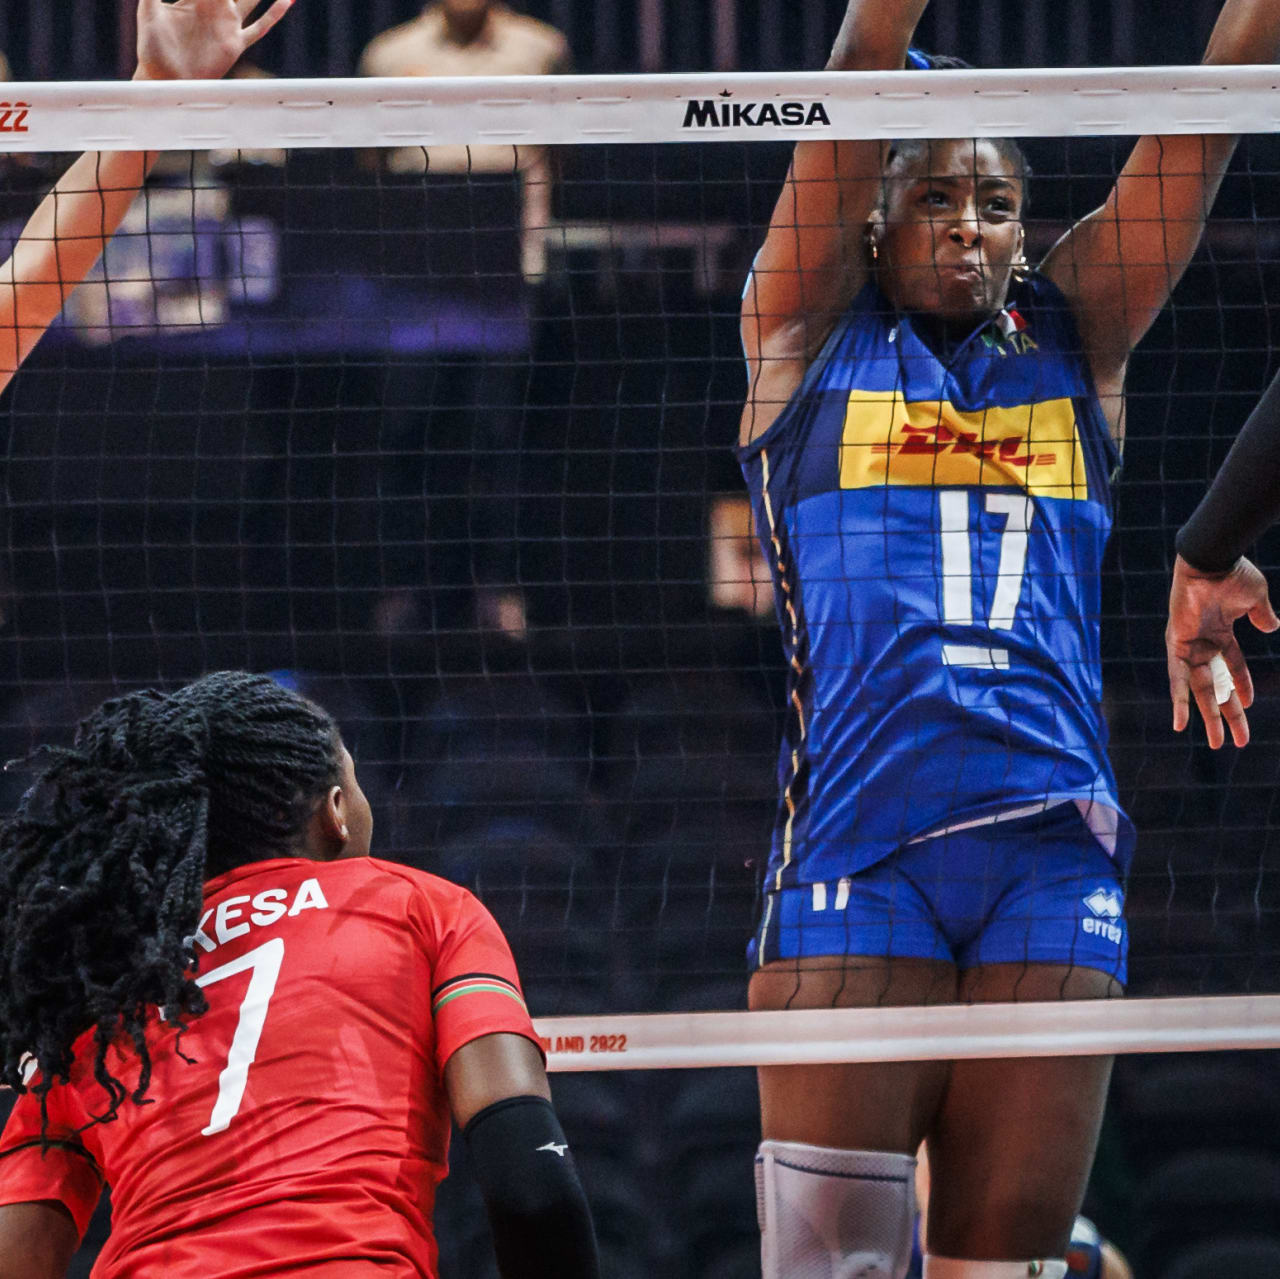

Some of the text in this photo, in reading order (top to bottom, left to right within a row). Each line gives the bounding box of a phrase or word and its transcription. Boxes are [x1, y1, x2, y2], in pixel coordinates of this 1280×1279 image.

[682, 100, 831, 128] MIKASA
[897, 423, 1036, 467] DHL
[939, 490, 1036, 631] 17
[194, 937, 286, 1137] 7
[589, 1033, 628, 1053] 2022
